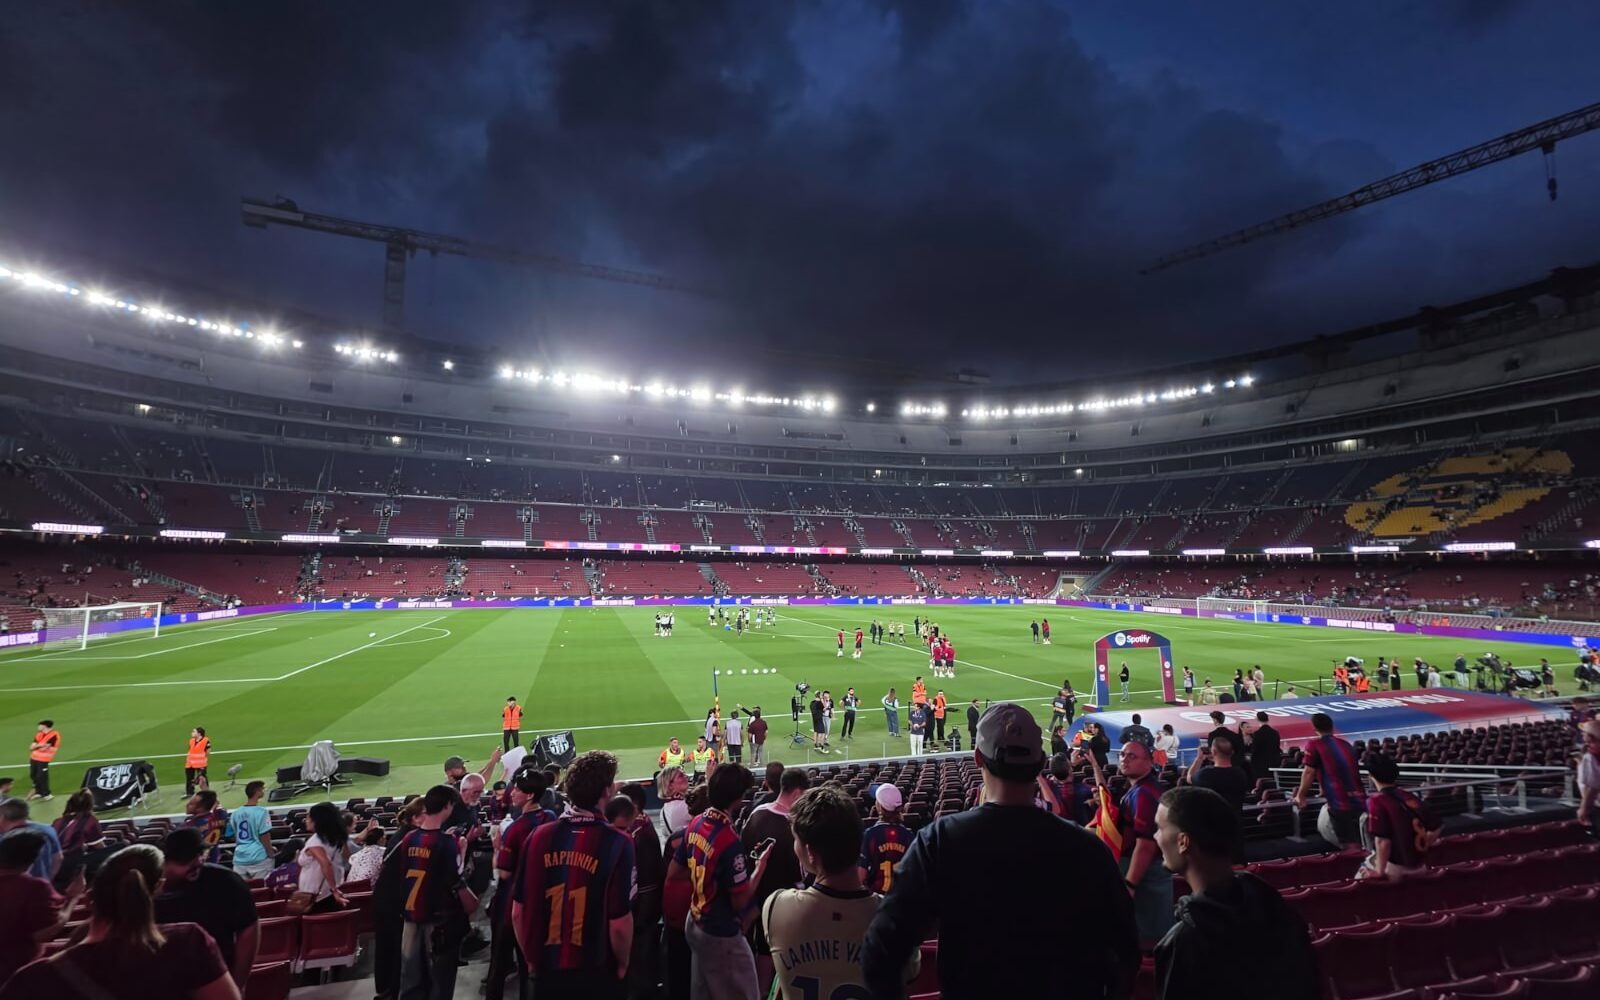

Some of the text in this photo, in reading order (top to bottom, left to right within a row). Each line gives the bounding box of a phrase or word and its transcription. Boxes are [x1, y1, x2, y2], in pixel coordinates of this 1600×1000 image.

[1126, 634, 1151, 644] Spotify
[238, 820, 250, 840] 8
[543, 850, 599, 875] RAPHINHA
[405, 868, 426, 911] 7
[544, 882, 587, 946] 11
[780, 940, 840, 970] LAMINE
